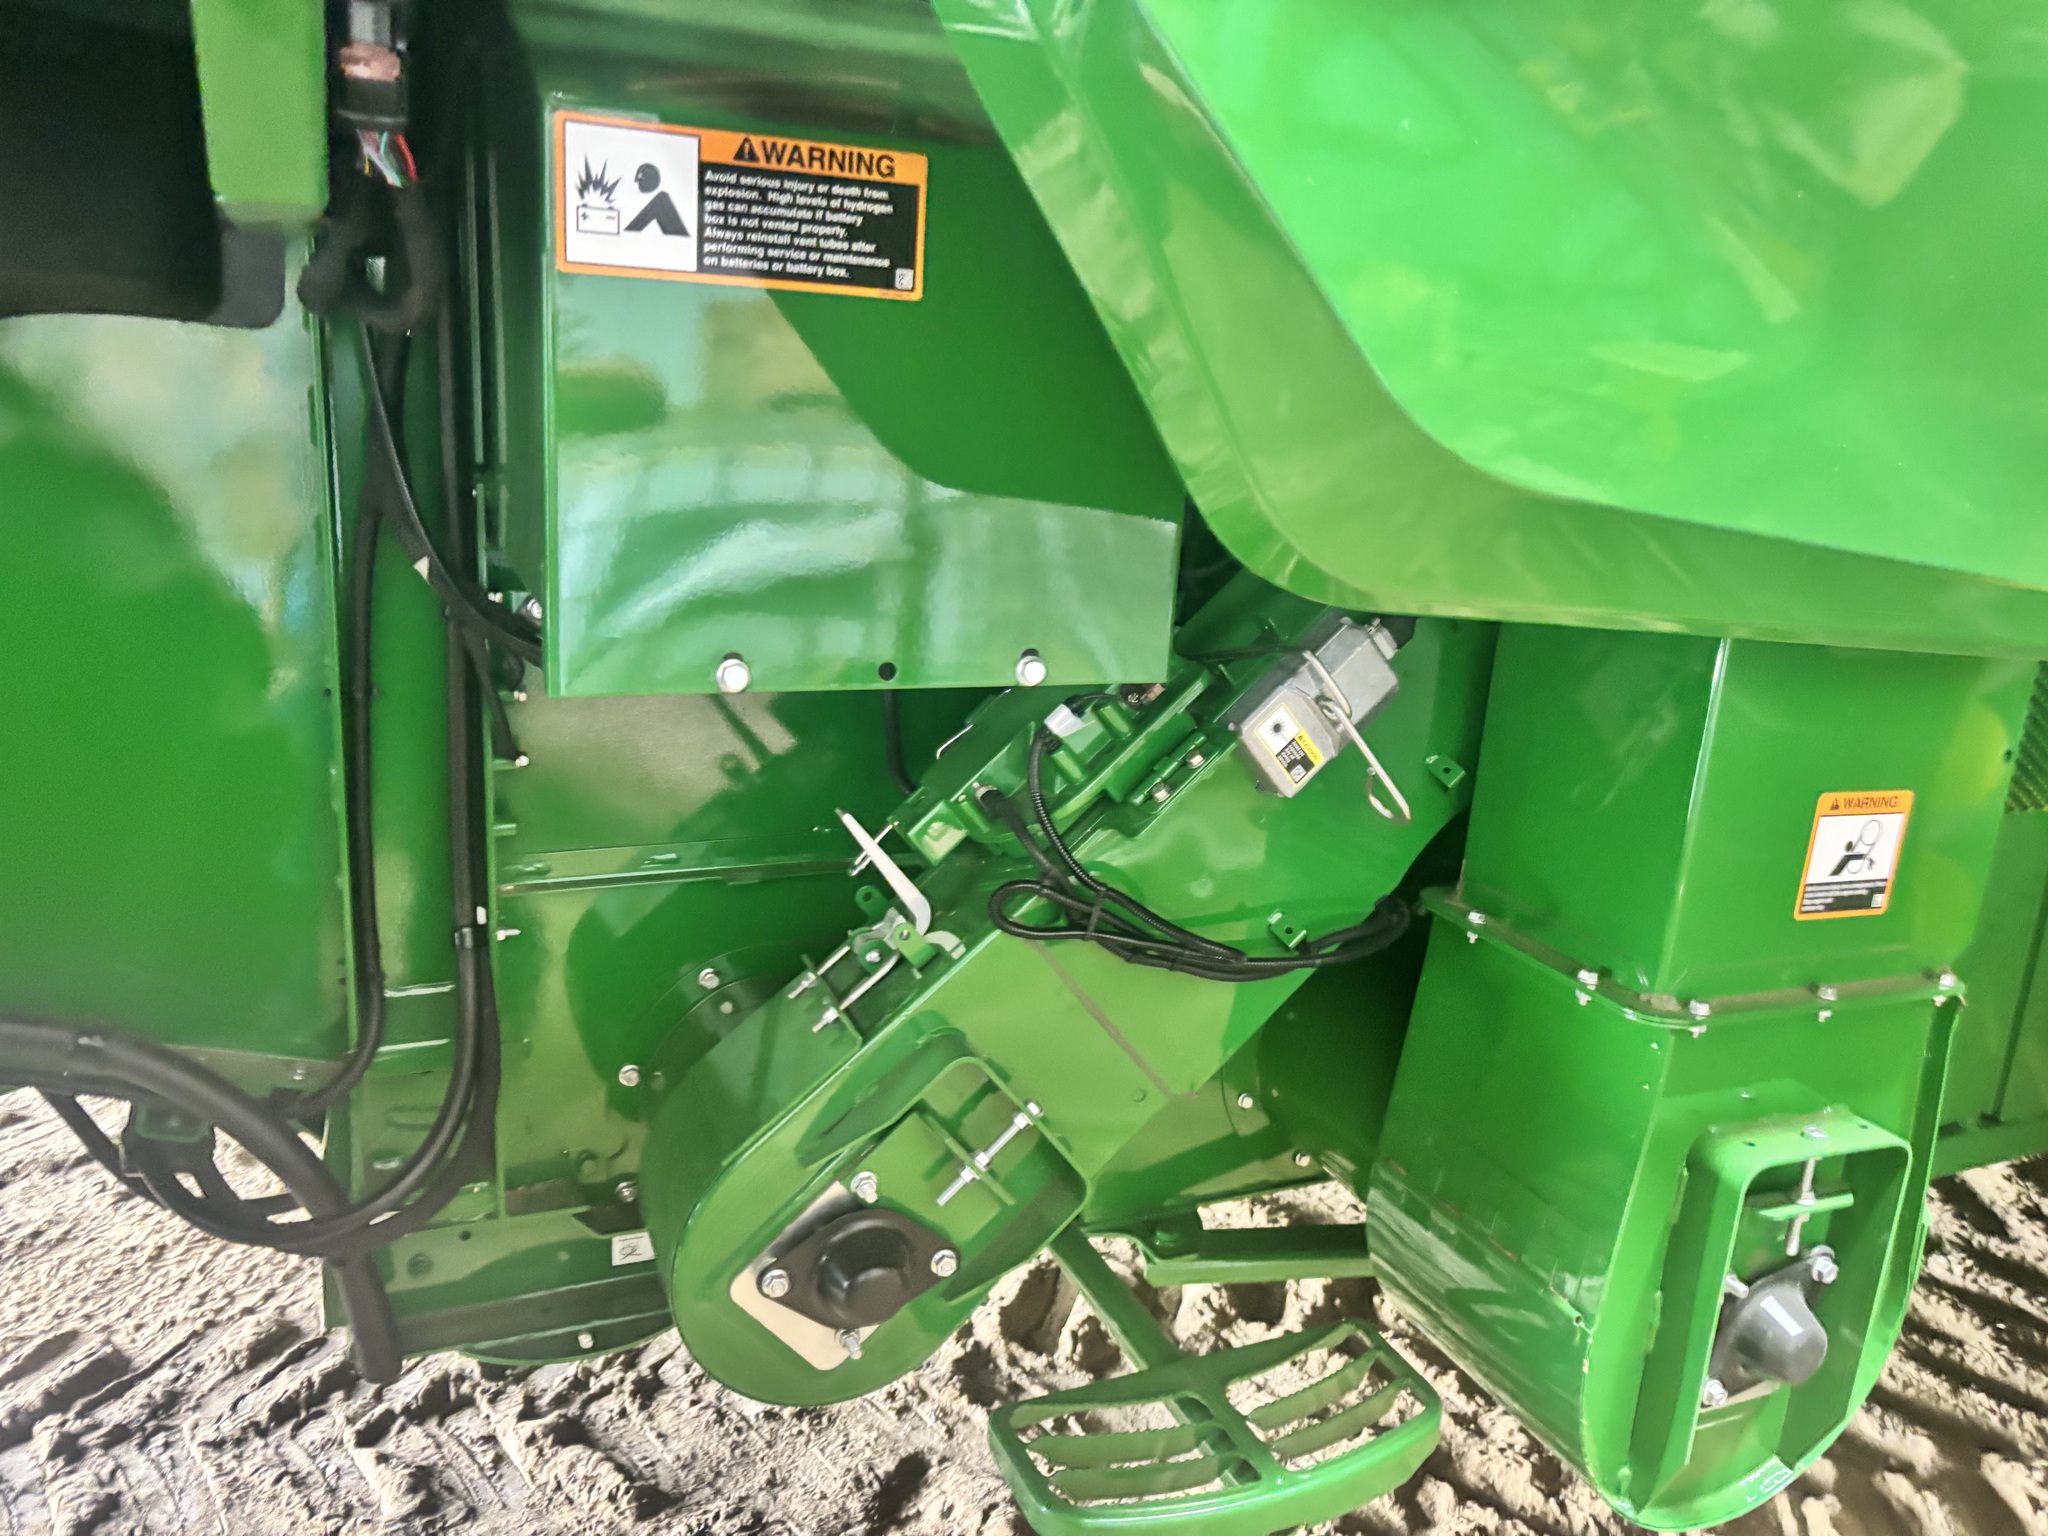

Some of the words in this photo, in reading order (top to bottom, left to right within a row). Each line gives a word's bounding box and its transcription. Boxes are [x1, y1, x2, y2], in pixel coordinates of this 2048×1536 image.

[761, 140, 896, 179] WARNING
[704, 170, 738, 184] Avoid
[740, 175, 782, 189] serious
[783, 179, 816, 193] injury
[817, 183, 830, 194] or
[831, 184, 862, 198] death
[863, 187, 889, 200] from
[704, 186, 763, 200] explosion.
[767, 190, 793, 206] High
[796, 194, 828, 208] levels
[829, 197, 842, 209] of
[843, 198, 893, 216] hydrogen
[704, 200, 725, 212] gas
[727, 202, 749, 213] can
[750, 204, 814, 220] accumulate
[815, 208, 824, 220] if
[825, 210, 864, 227] battery
[704, 212, 725, 225] box
[727, 214, 739, 226] is
[740, 217, 760, 229] not
[761, 220, 800, 232] vented
[703, 241, 765, 259] performing
[766, 247, 807, 260] service
[808, 251, 821, 261] or
[704, 226, 744, 242] Always
[746, 229, 791, 245] reinstall
[793, 235, 817, 248] vent
[818, 238, 850, 251] tubes
[851, 241, 877, 253] after
[703, 256, 719, 266] on
[720, 256, 770, 271] batteries
[771, 261, 784, 272] or
[786, 261, 825, 278] battery
[1843, 795, 1898, 810] WARNING
